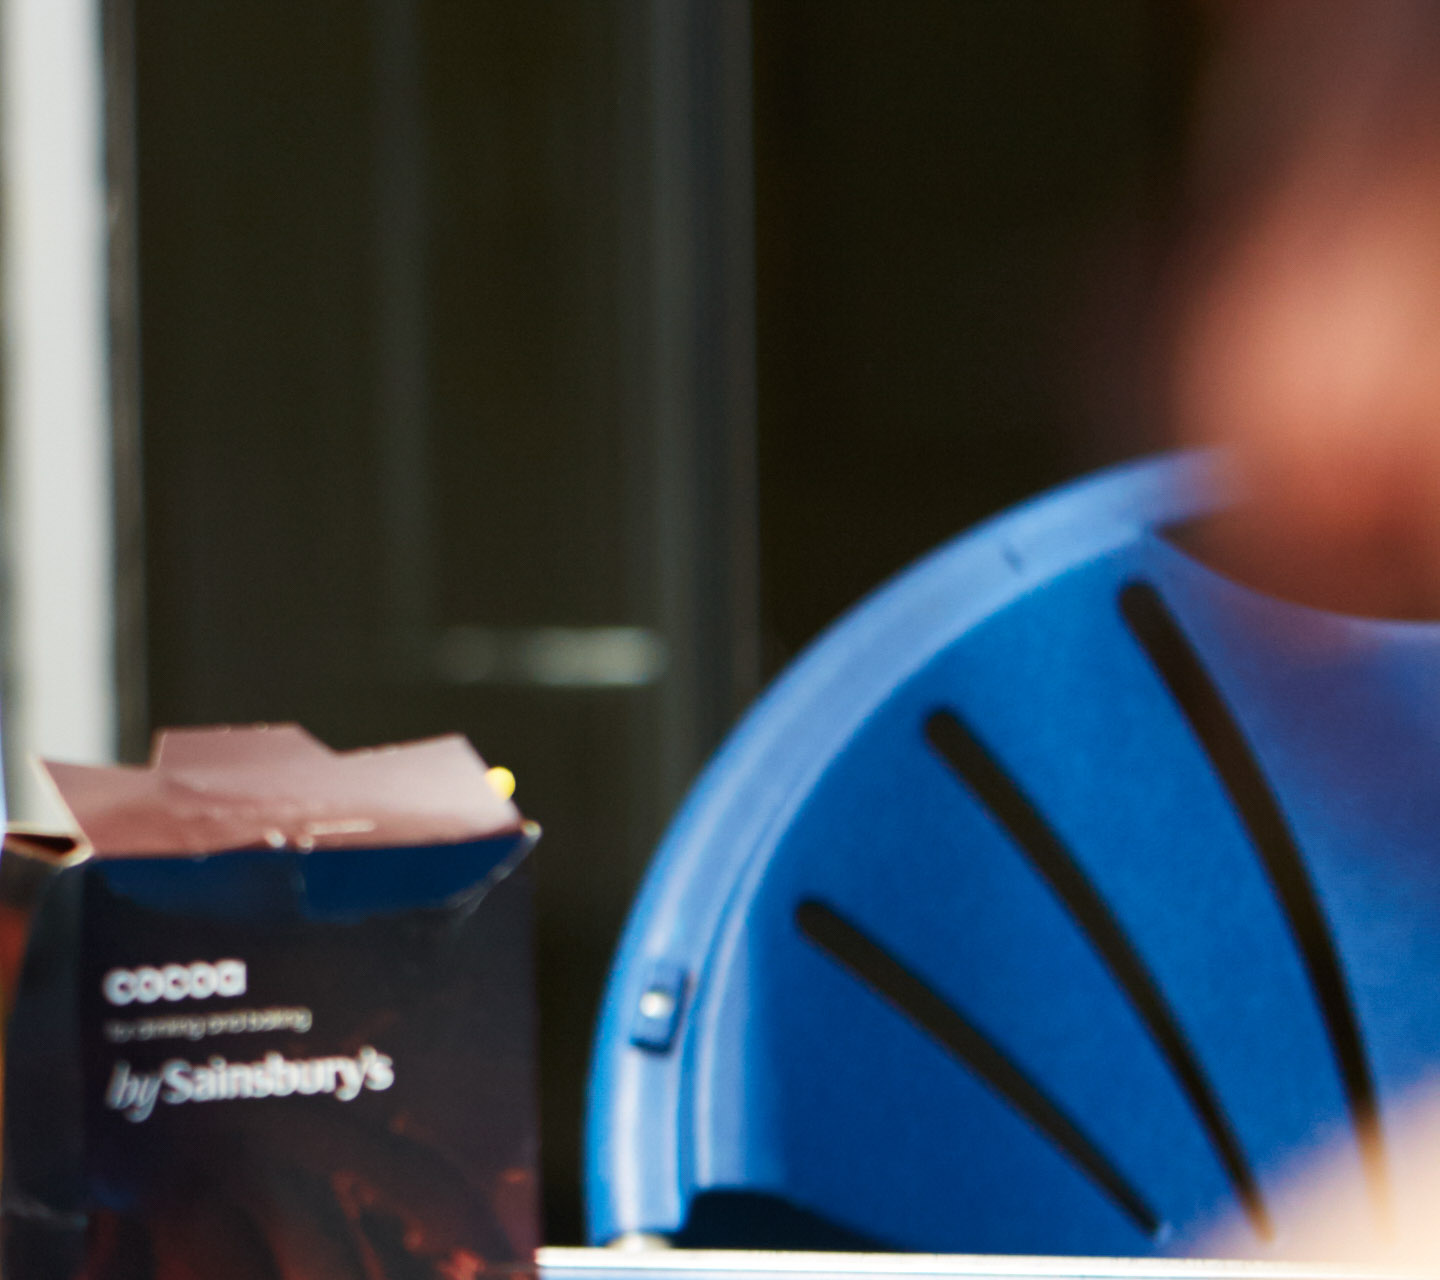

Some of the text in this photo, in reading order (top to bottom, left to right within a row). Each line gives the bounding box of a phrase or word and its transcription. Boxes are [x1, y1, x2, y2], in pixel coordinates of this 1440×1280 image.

[102, 959, 248, 1006] cocoa
[105, 1044, 395, 1123] by Sainsbury's
